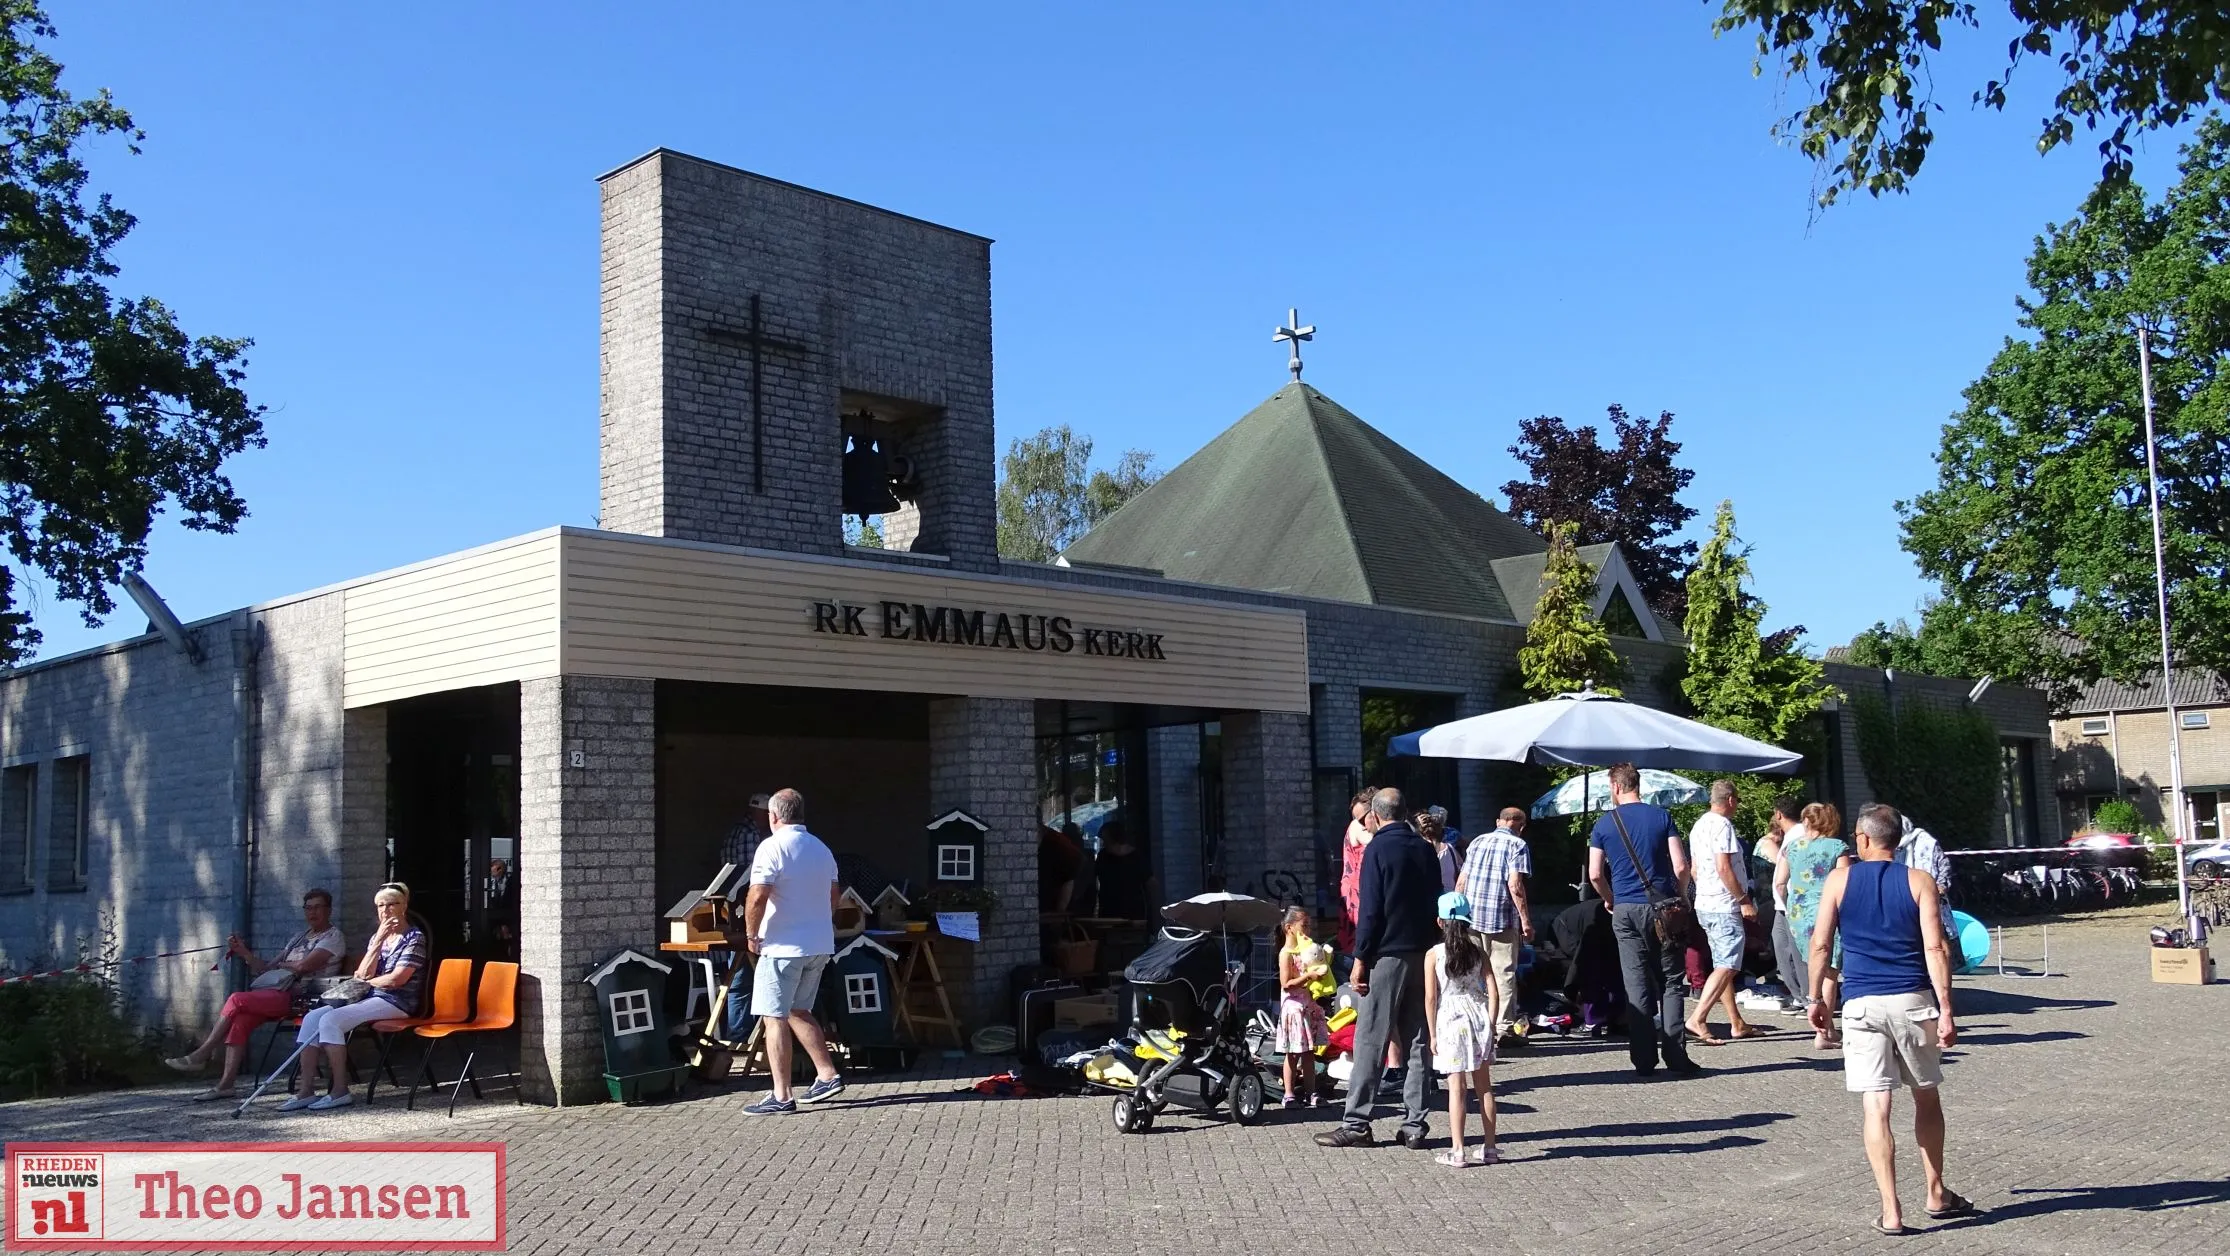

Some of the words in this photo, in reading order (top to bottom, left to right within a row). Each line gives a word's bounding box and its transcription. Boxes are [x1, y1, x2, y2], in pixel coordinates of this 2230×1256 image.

[813, 601, 868, 637] RK
[880, 600, 1074, 653] EMMAUS
[1083, 627, 1167, 661] KERK
[575, 753, 581, 765] 2
